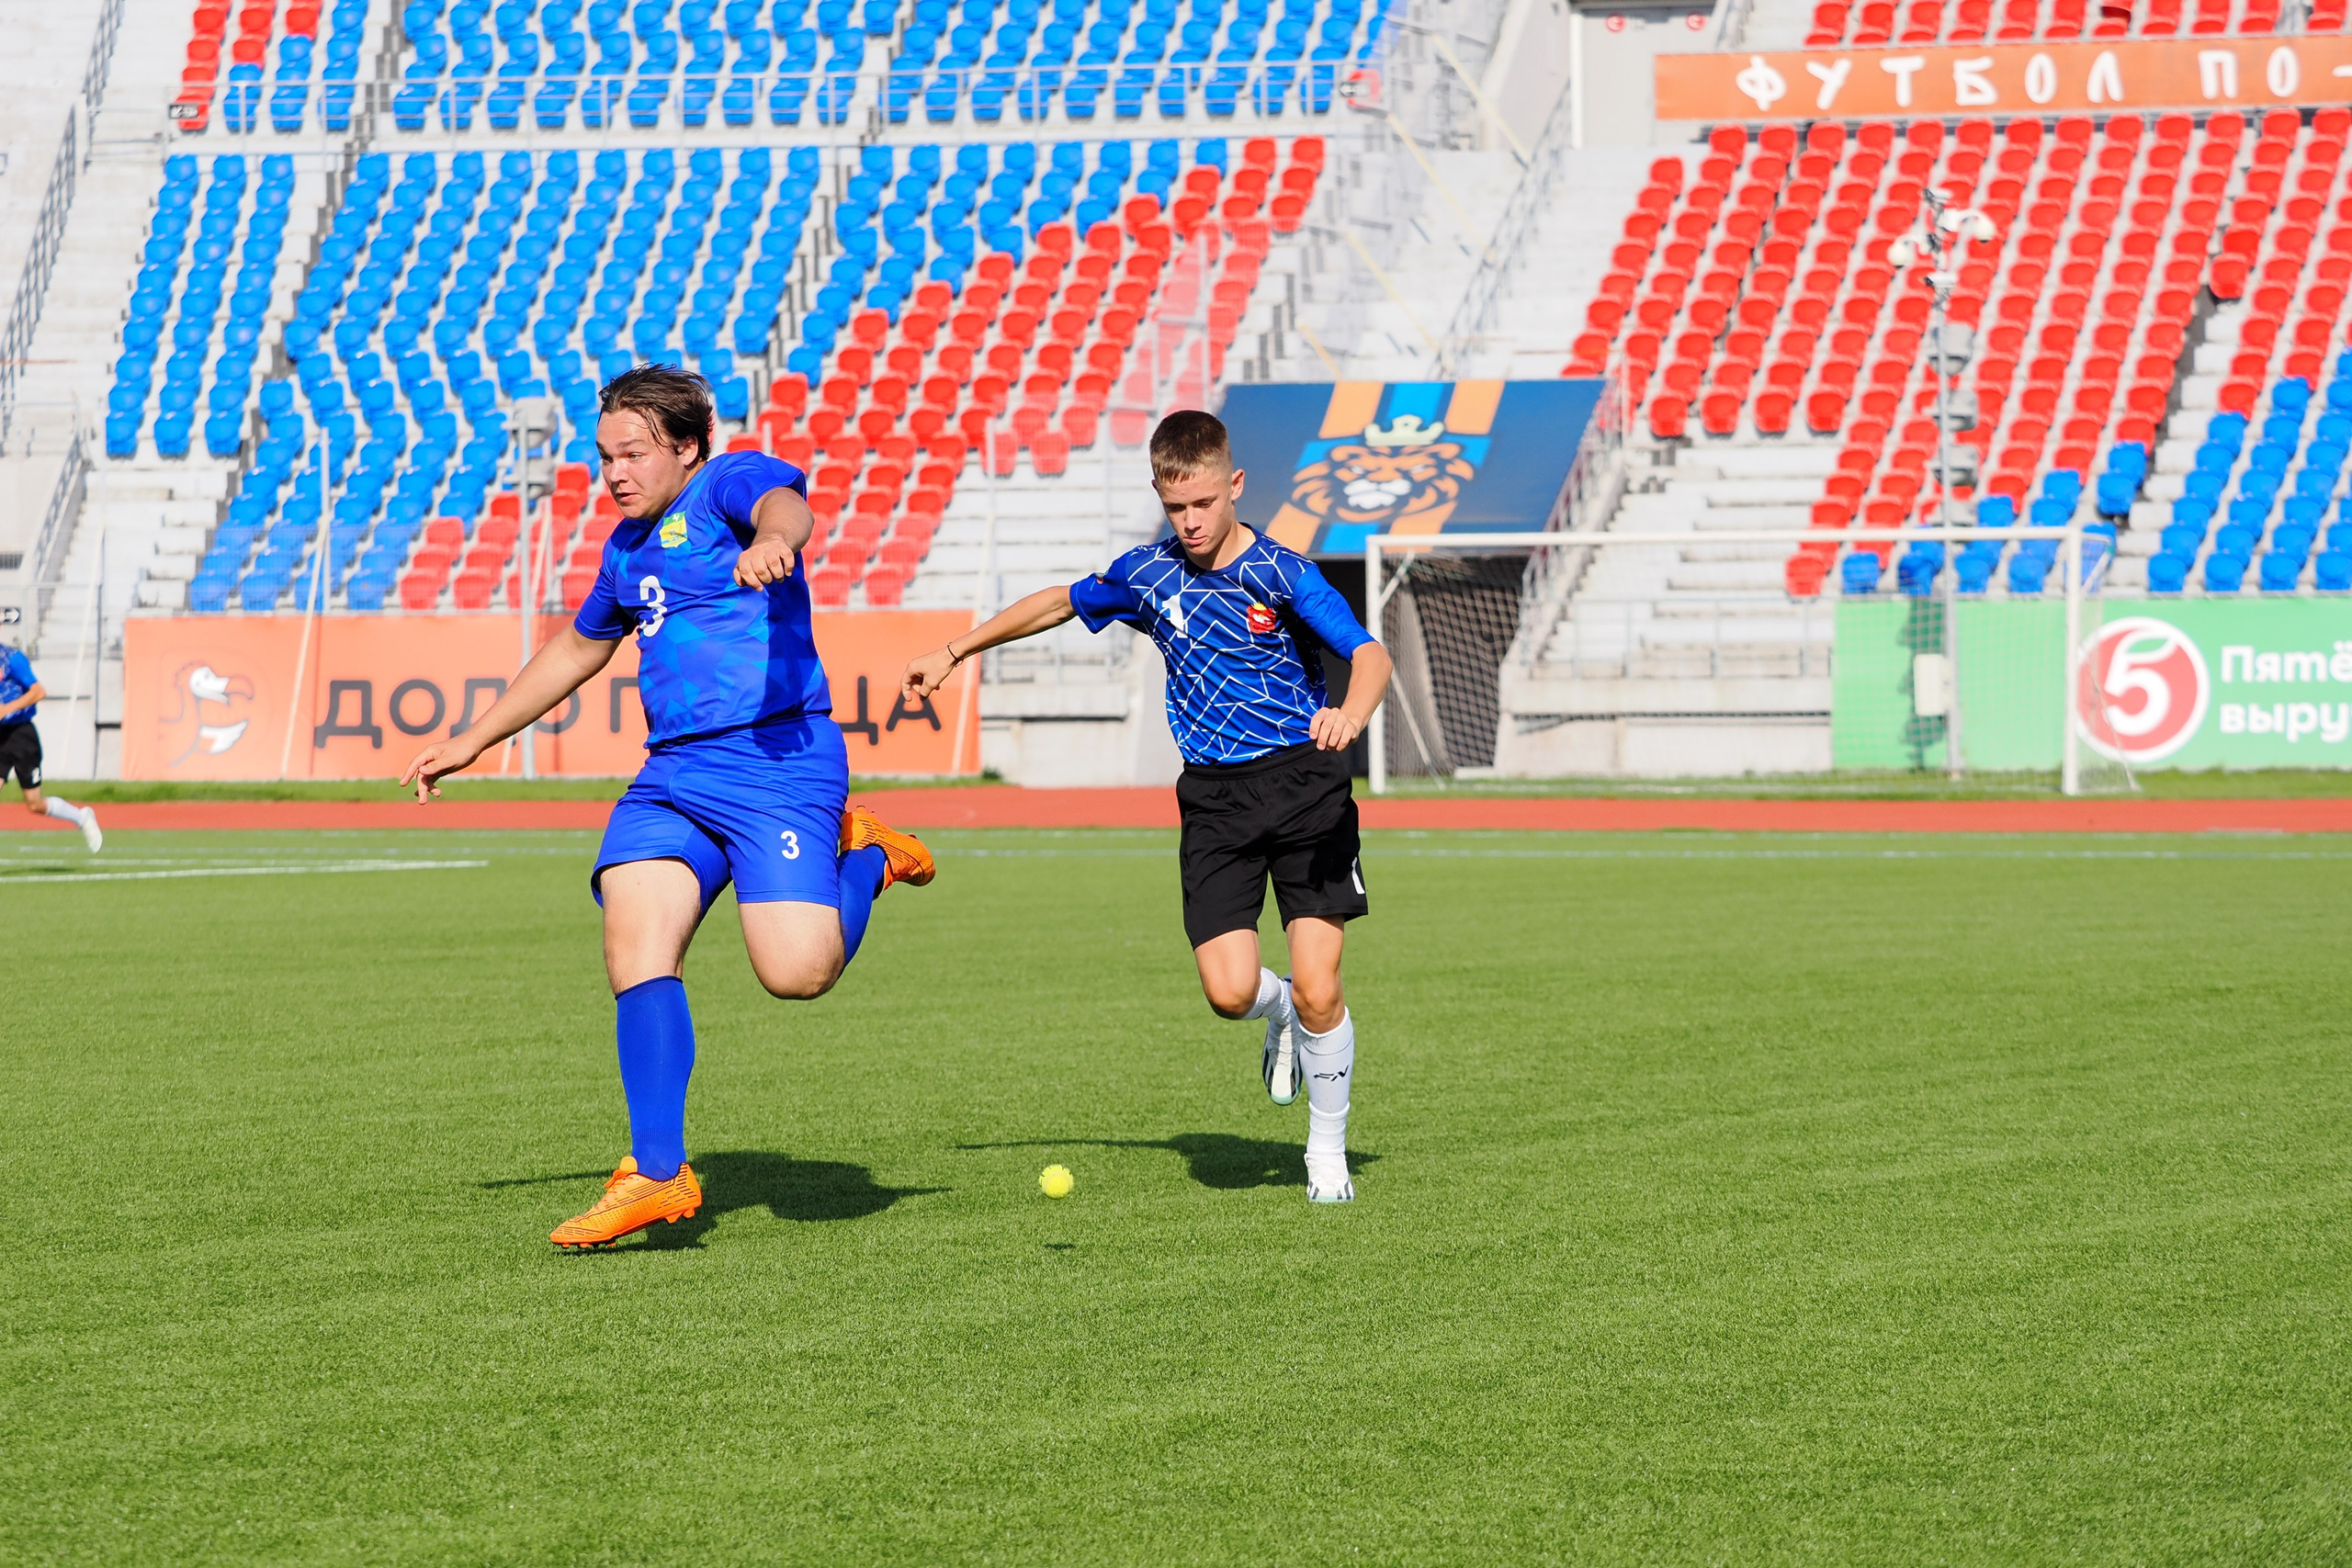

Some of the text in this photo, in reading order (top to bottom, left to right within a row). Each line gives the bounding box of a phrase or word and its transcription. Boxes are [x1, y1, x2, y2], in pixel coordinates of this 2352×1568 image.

[1736, 51, 2124, 112] ФУТБОЛ
[639, 574, 668, 637] 3
[1161, 594, 1189, 638] 1
[2103, 628, 2177, 736] 5
[780, 829, 800, 860] 3
